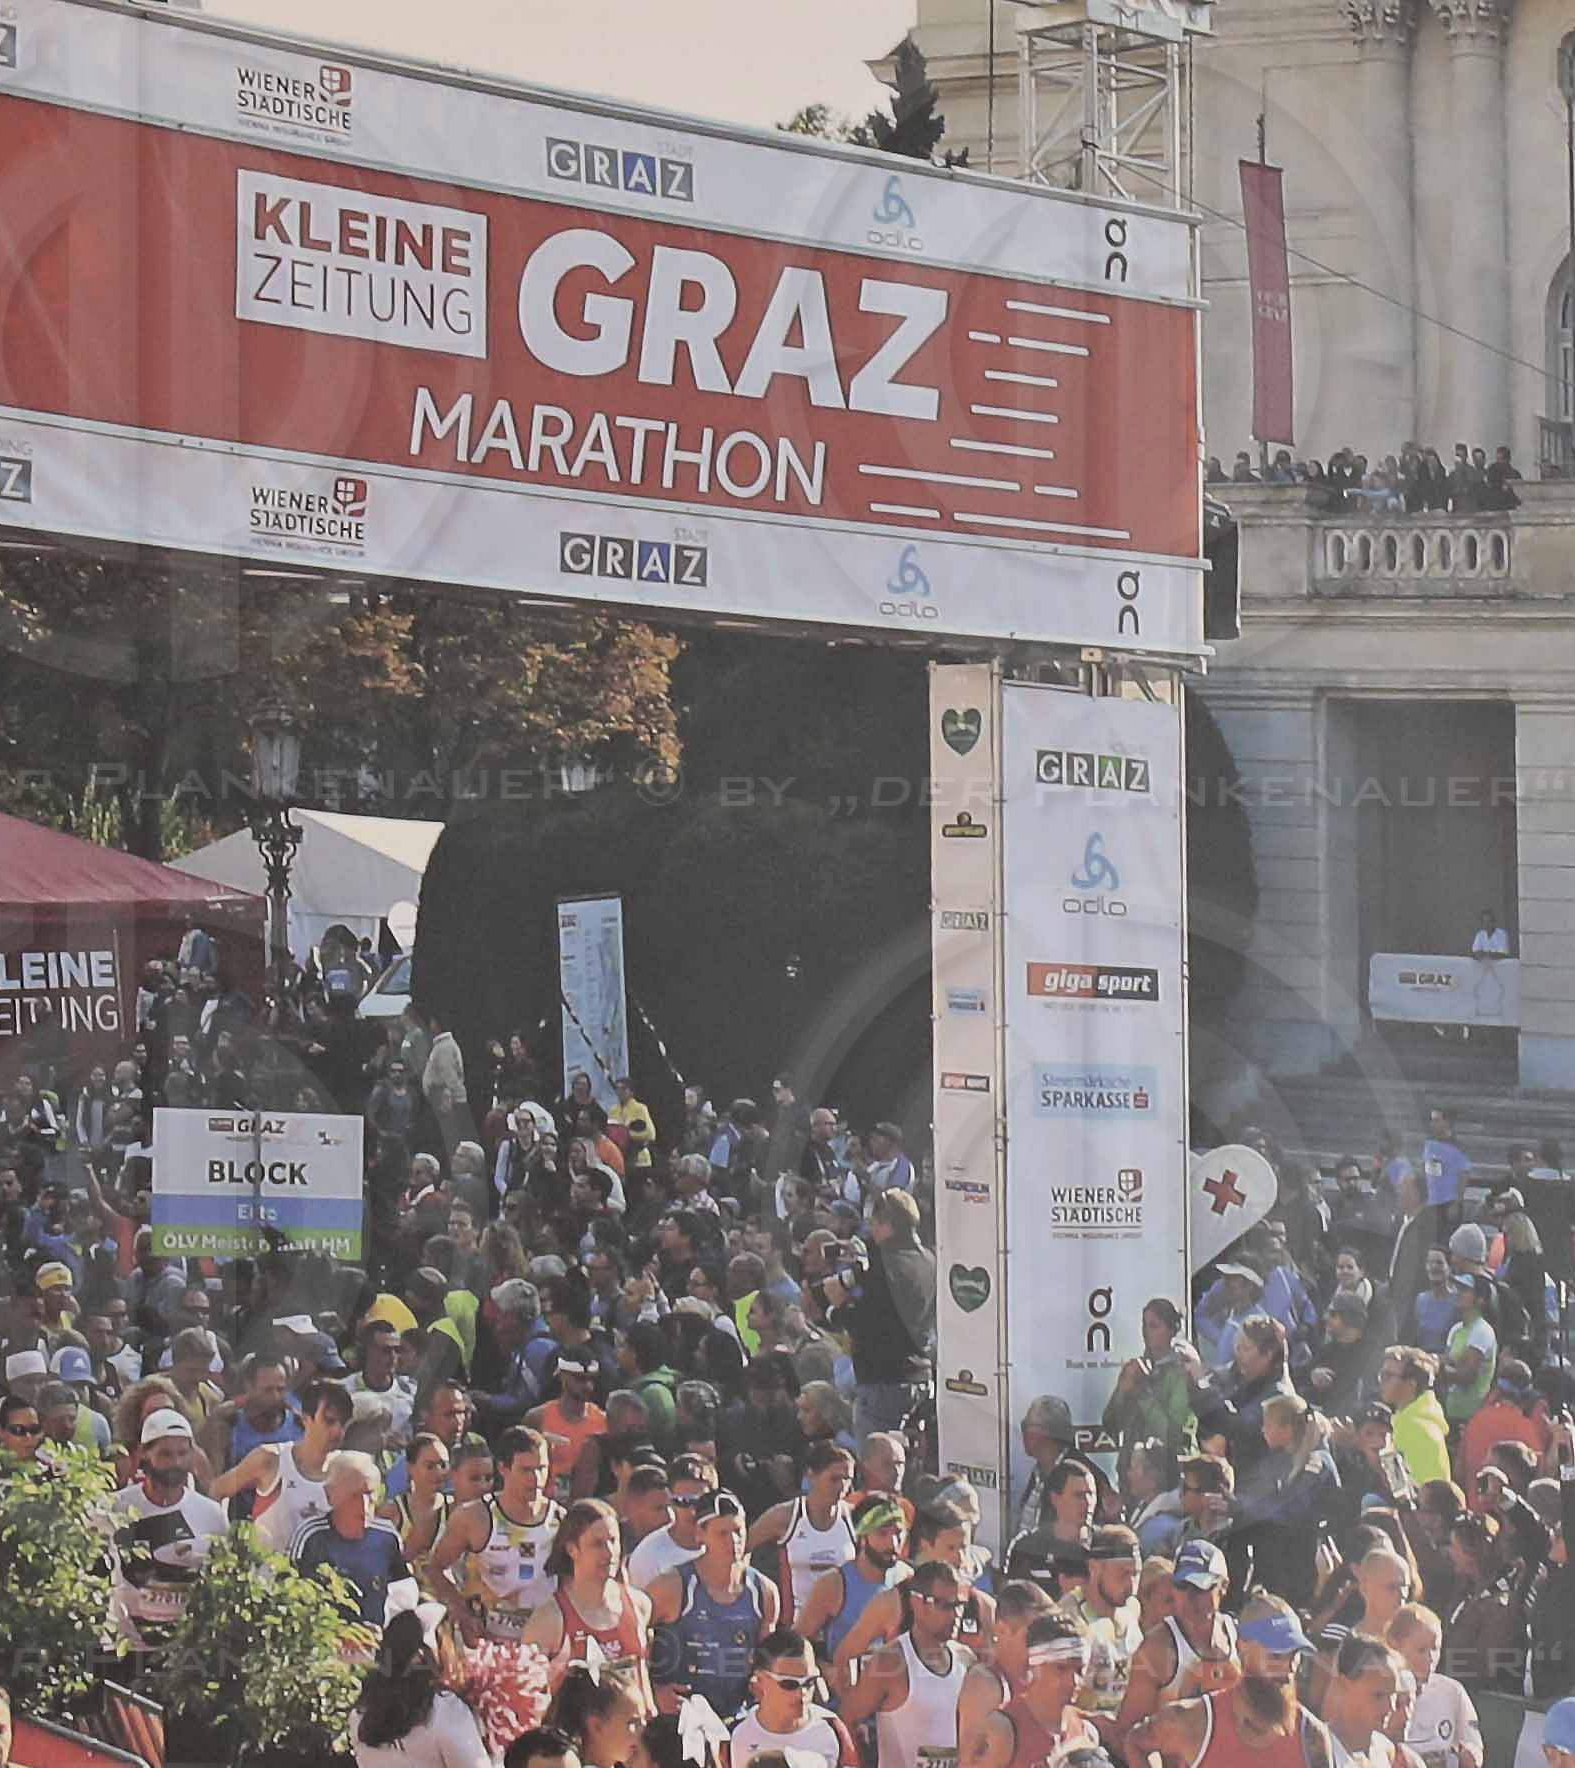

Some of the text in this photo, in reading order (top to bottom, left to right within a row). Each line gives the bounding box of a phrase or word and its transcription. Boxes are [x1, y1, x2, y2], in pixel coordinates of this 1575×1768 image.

[237, 67, 315, 101] WIENER
[547, 138, 692, 200] GRAZ
[254, 192, 472, 277] KLEINE
[253, 253, 472, 335] ZEITUNG
[519, 228, 949, 421] GRAZ
[411, 387, 826, 506] MARATHON
[251, 486, 329, 514] WIENER
[561, 533, 706, 586] GRAZ
[1037, 751, 1150, 792] GRAZ
[1062, 896, 1128, 917] odlo
[1044, 967, 1152, 995] giga sport
[1041, 1089, 1131, 1110] SPARKASSE
[208, 1160, 308, 1186] BLOCK
[1051, 1187, 1115, 1204] WIENER
